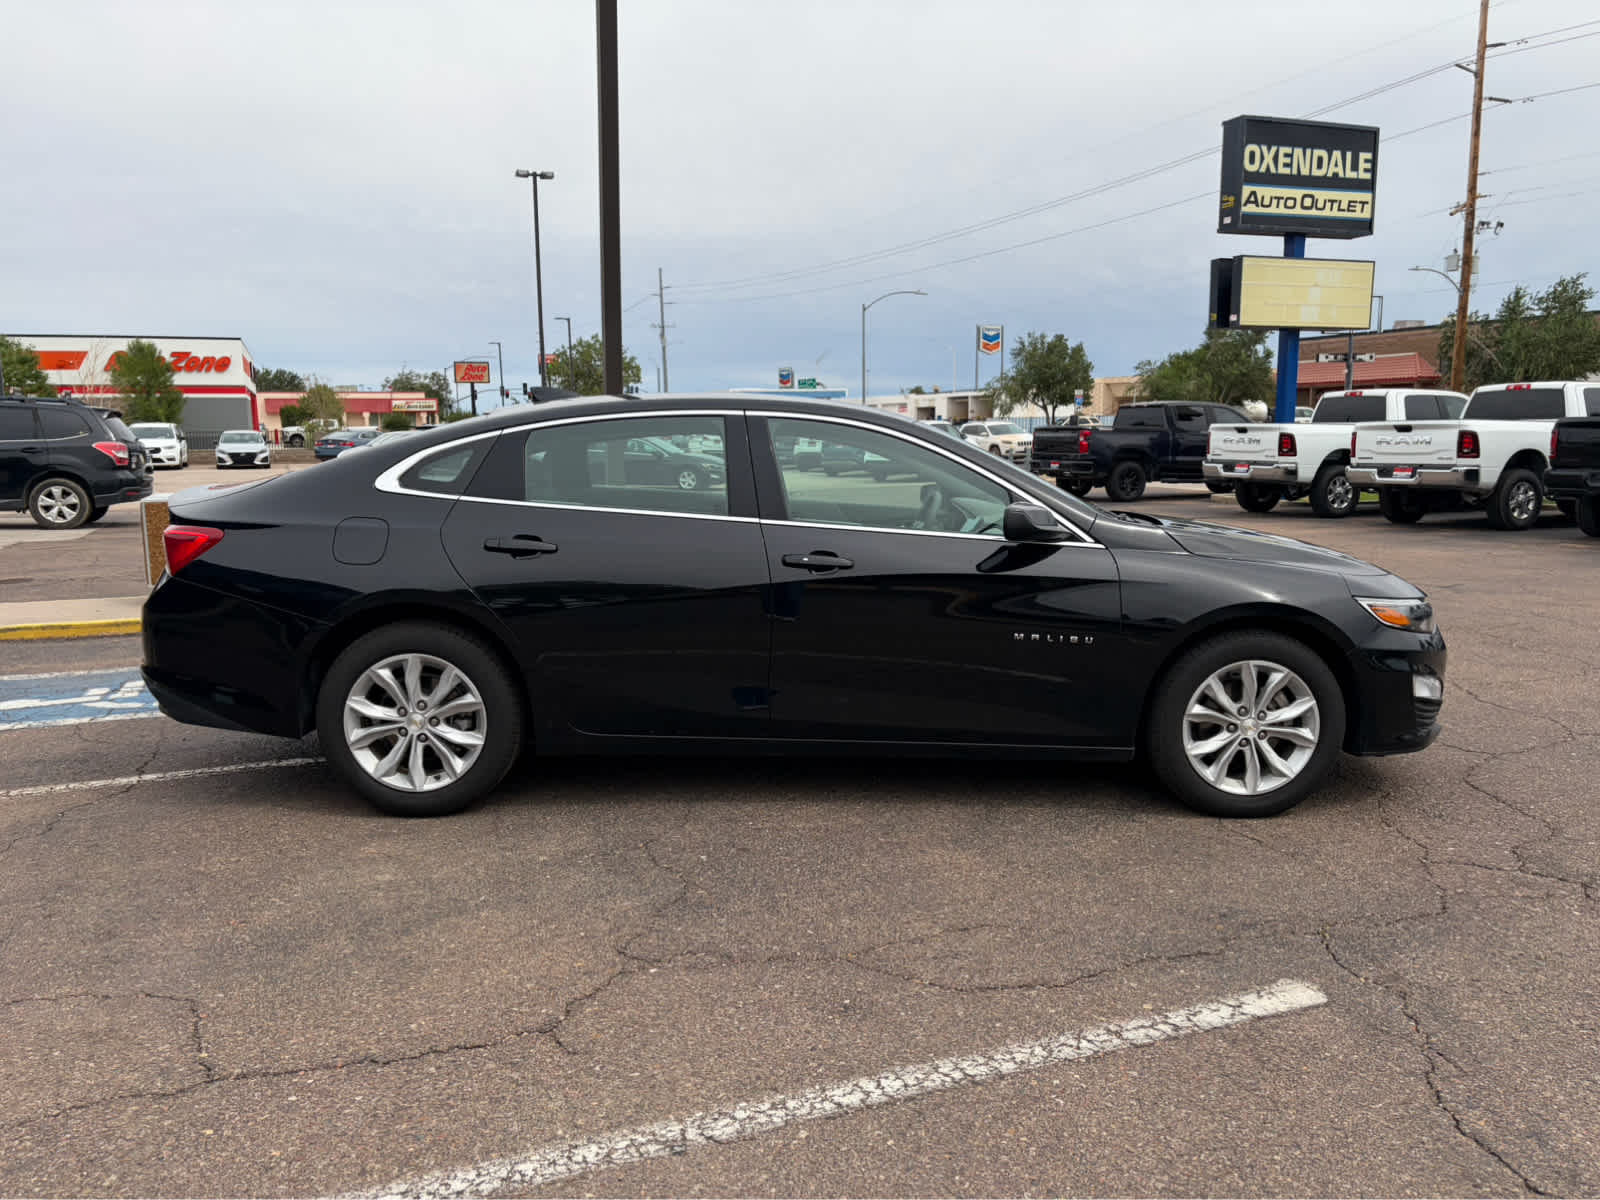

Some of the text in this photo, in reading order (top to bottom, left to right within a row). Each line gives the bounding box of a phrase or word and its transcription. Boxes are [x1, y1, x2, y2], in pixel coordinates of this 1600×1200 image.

[1243, 144, 1373, 179] OXENDALE
[1223, 435, 1261, 446] RAM
[1376, 434, 1432, 446] RAM
[1013, 633, 1094, 644] MALIBU
